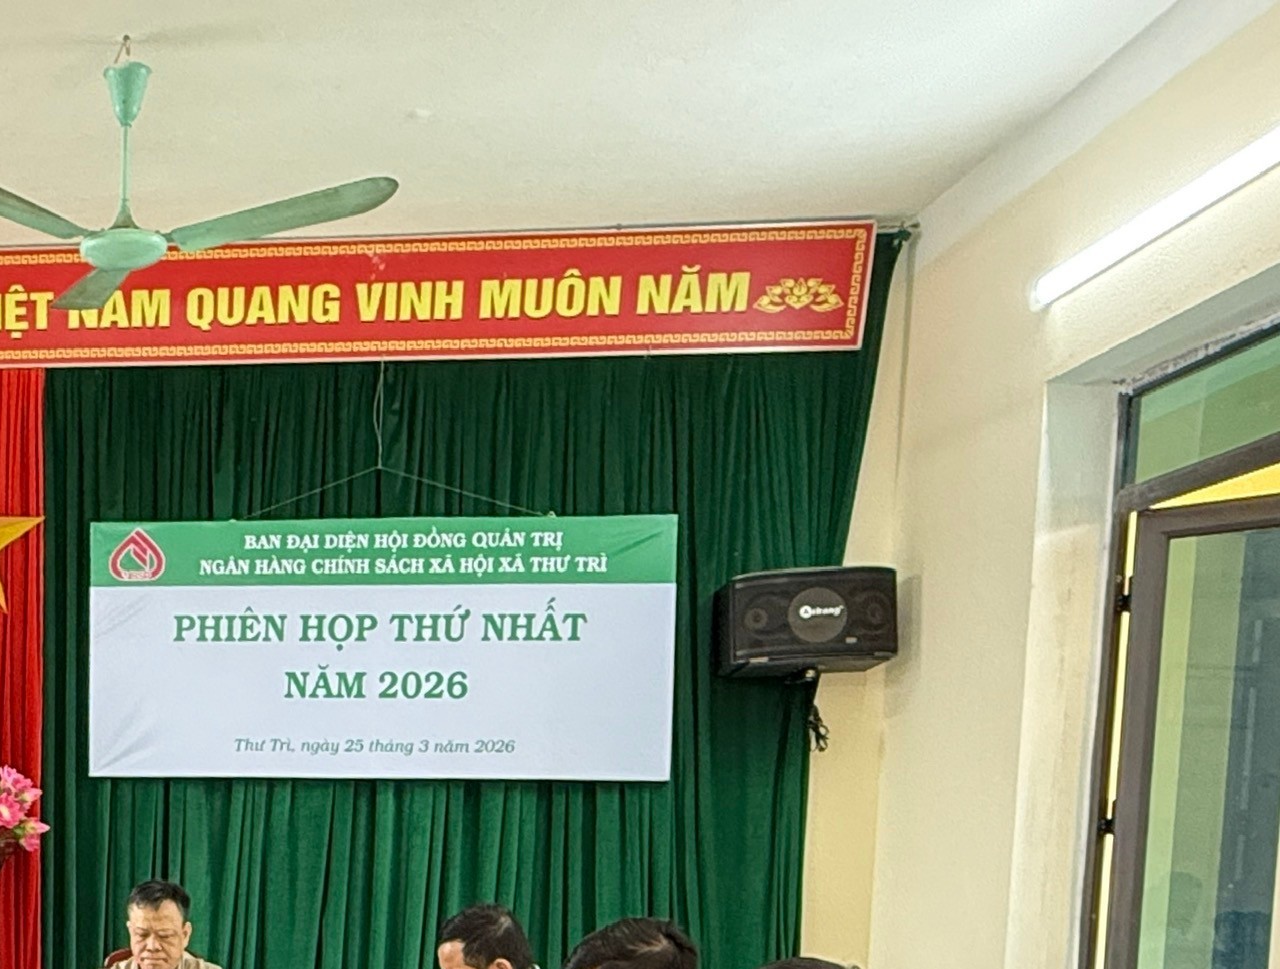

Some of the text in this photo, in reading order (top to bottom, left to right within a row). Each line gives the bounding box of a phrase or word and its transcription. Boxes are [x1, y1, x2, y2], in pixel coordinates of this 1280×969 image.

[68, 288, 171, 330] NAM
[187, 283, 340, 332] QUANG
[355, 280, 464, 323] VINH
[479, 268, 622, 320] MUÔN
[637, 265, 751, 316] NĂM
[243, 525, 564, 553] BAN ĐẠI DIỆN HỘI ĐỒNG QUẢN TRỊ
[199, 552, 608, 577] NGÂN HÀNG CHÍNH SÁCH XÃ HỘI XÃ THƯ TRÌ
[174, 597, 588, 652] PHIÊN HỌP THỨ NHẤT
[284, 664, 468, 699] NĂM 2026
[234, 738, 267, 753] Thư
[301, 738, 340, 756] ngày
[344, 739, 365, 753] 25
[368, 739, 414, 757] tháng
[418, 739, 430, 753] 3
[434, 740, 470, 753] năm
[473, 739, 517, 754] 2026
